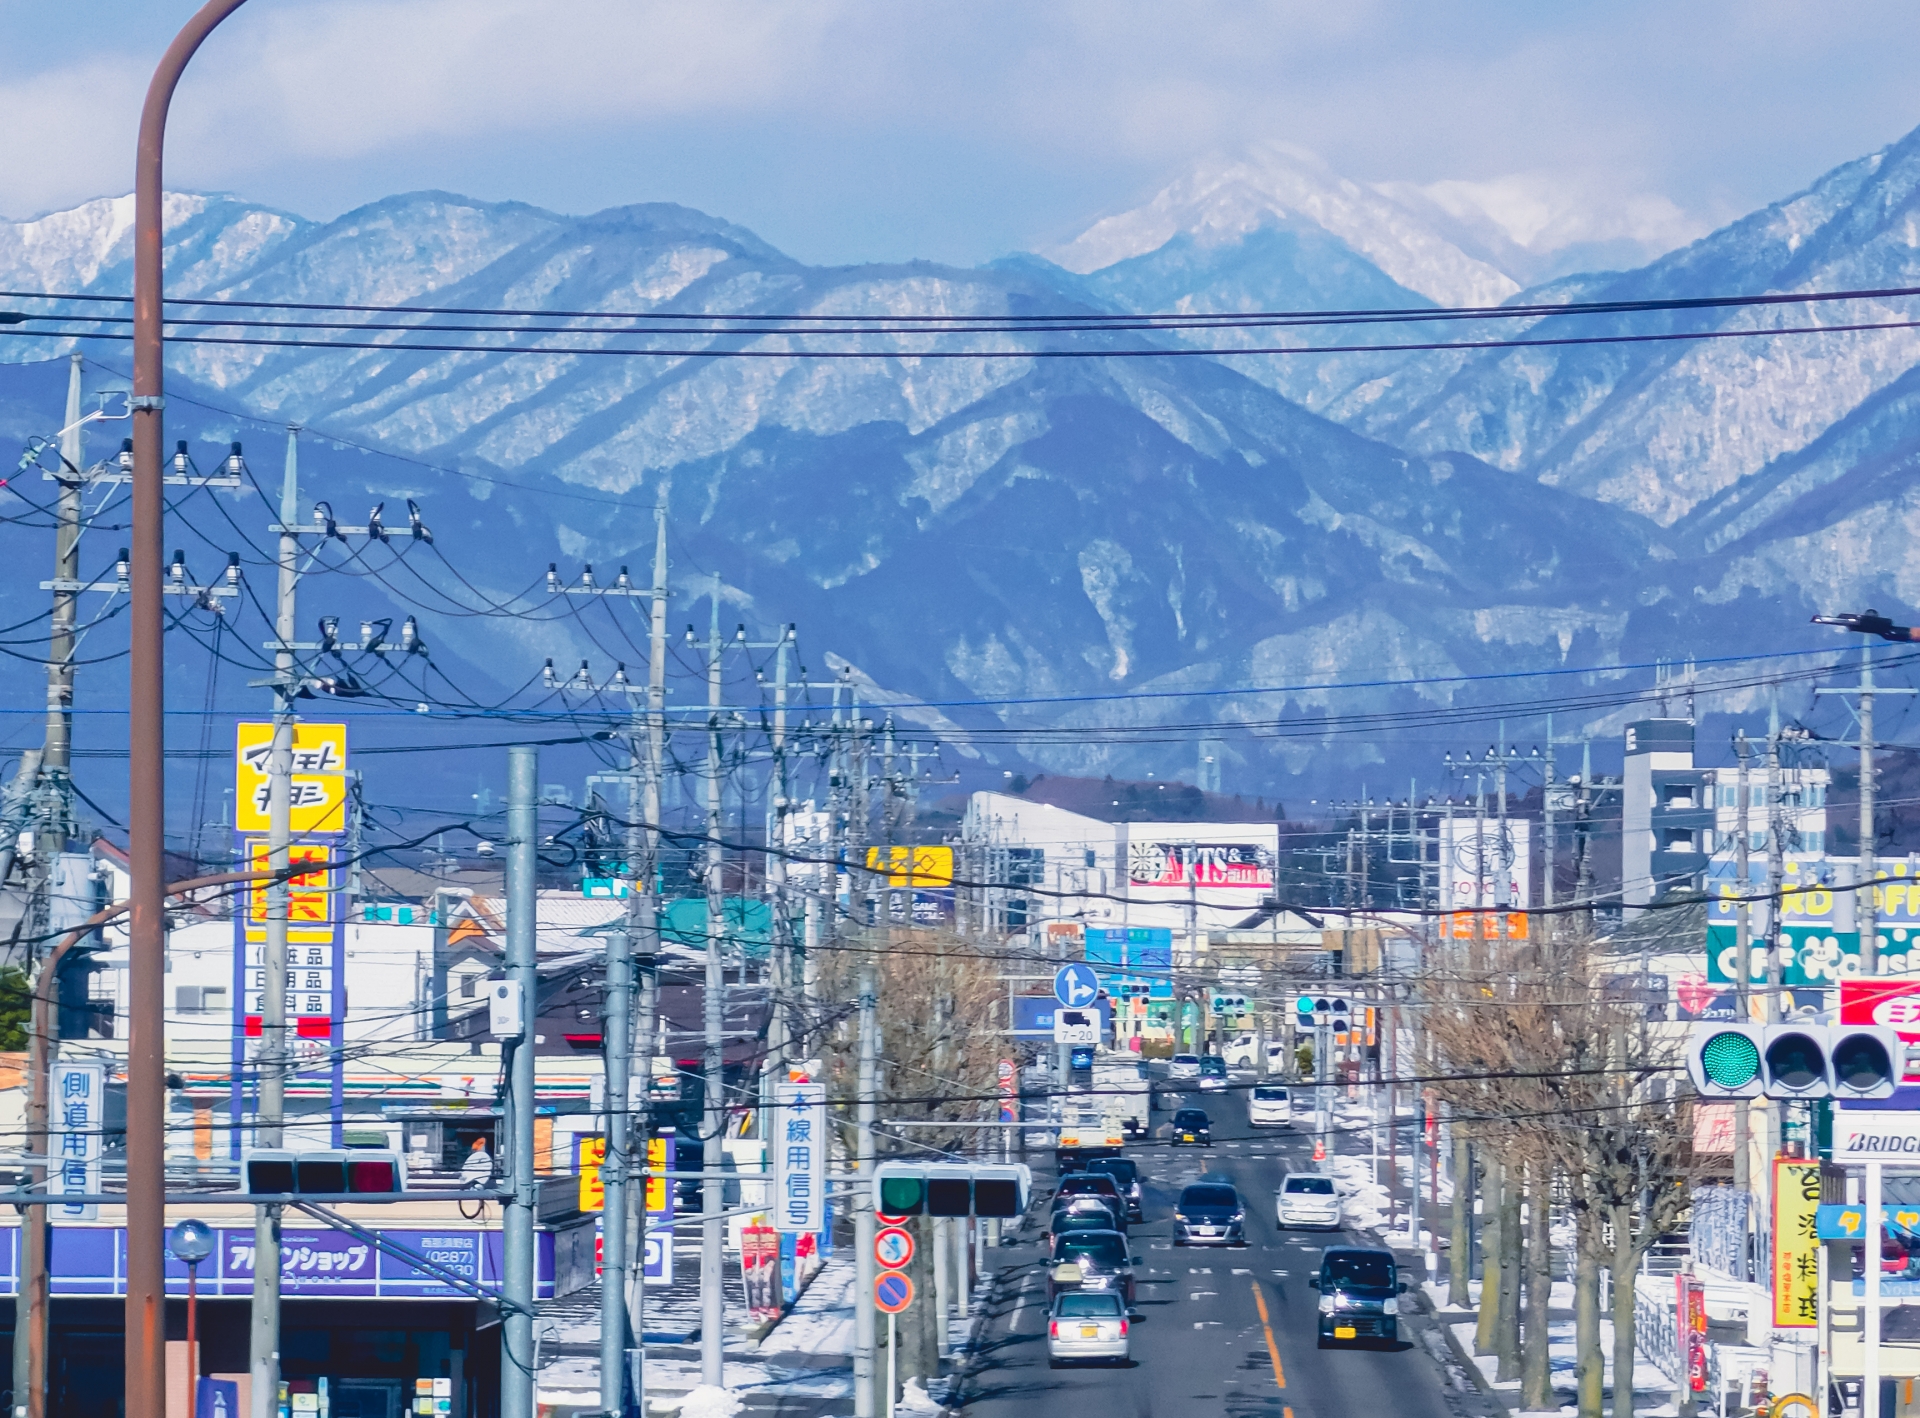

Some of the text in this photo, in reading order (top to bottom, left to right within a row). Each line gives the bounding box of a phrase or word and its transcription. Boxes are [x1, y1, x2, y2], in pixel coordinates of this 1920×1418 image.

[246, 746, 336, 771] マモト
[1451, 882, 1519, 895] TOOA
[1719, 883, 1834, 916] HRD
[1846, 1132, 1920, 1152] BRIDG
[786, 1090, 813, 1225] 本線用信号
[229, 1244, 369, 1271] アンショップ
[425, 1250, 474, 1263] (0287)
